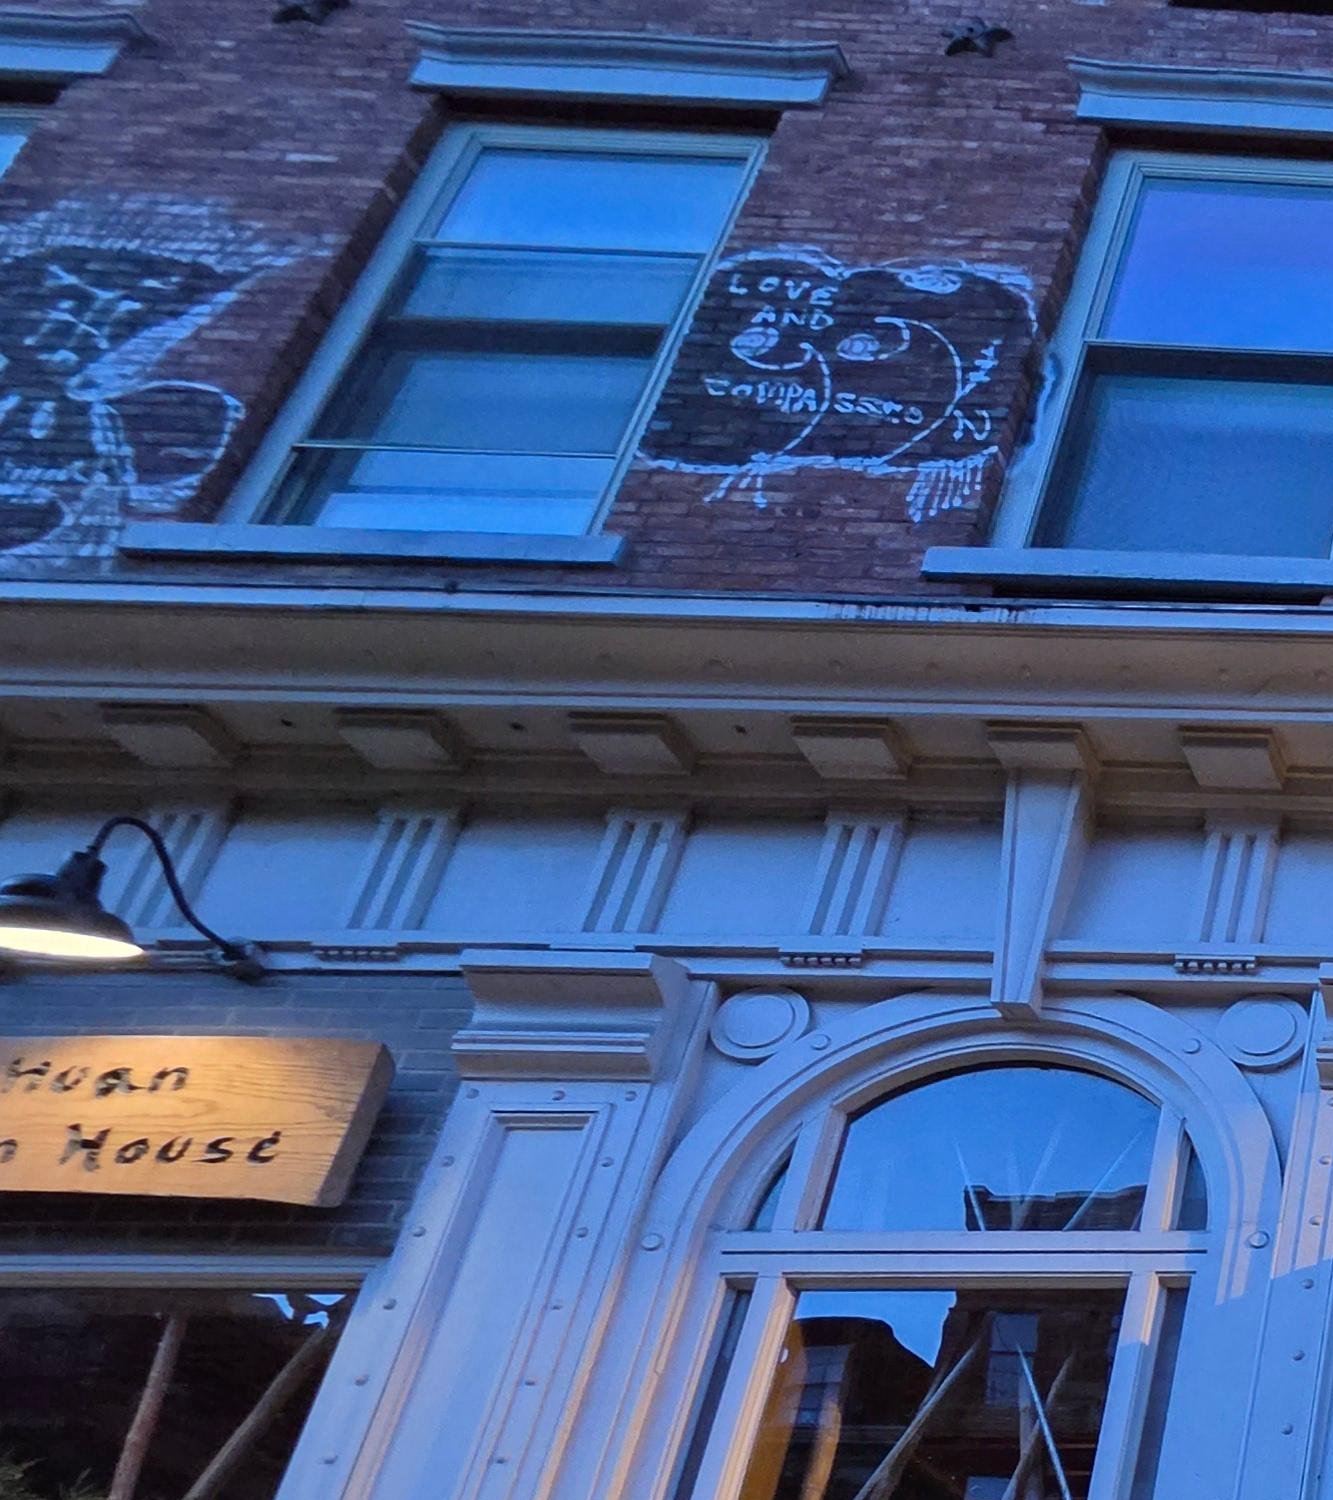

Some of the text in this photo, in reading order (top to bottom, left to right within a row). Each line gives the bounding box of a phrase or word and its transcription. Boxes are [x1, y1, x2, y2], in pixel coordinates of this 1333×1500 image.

[730, 277, 838, 306] LOVE
[750, 306, 834, 330] AND
[58, 1122, 283, 1174] House
